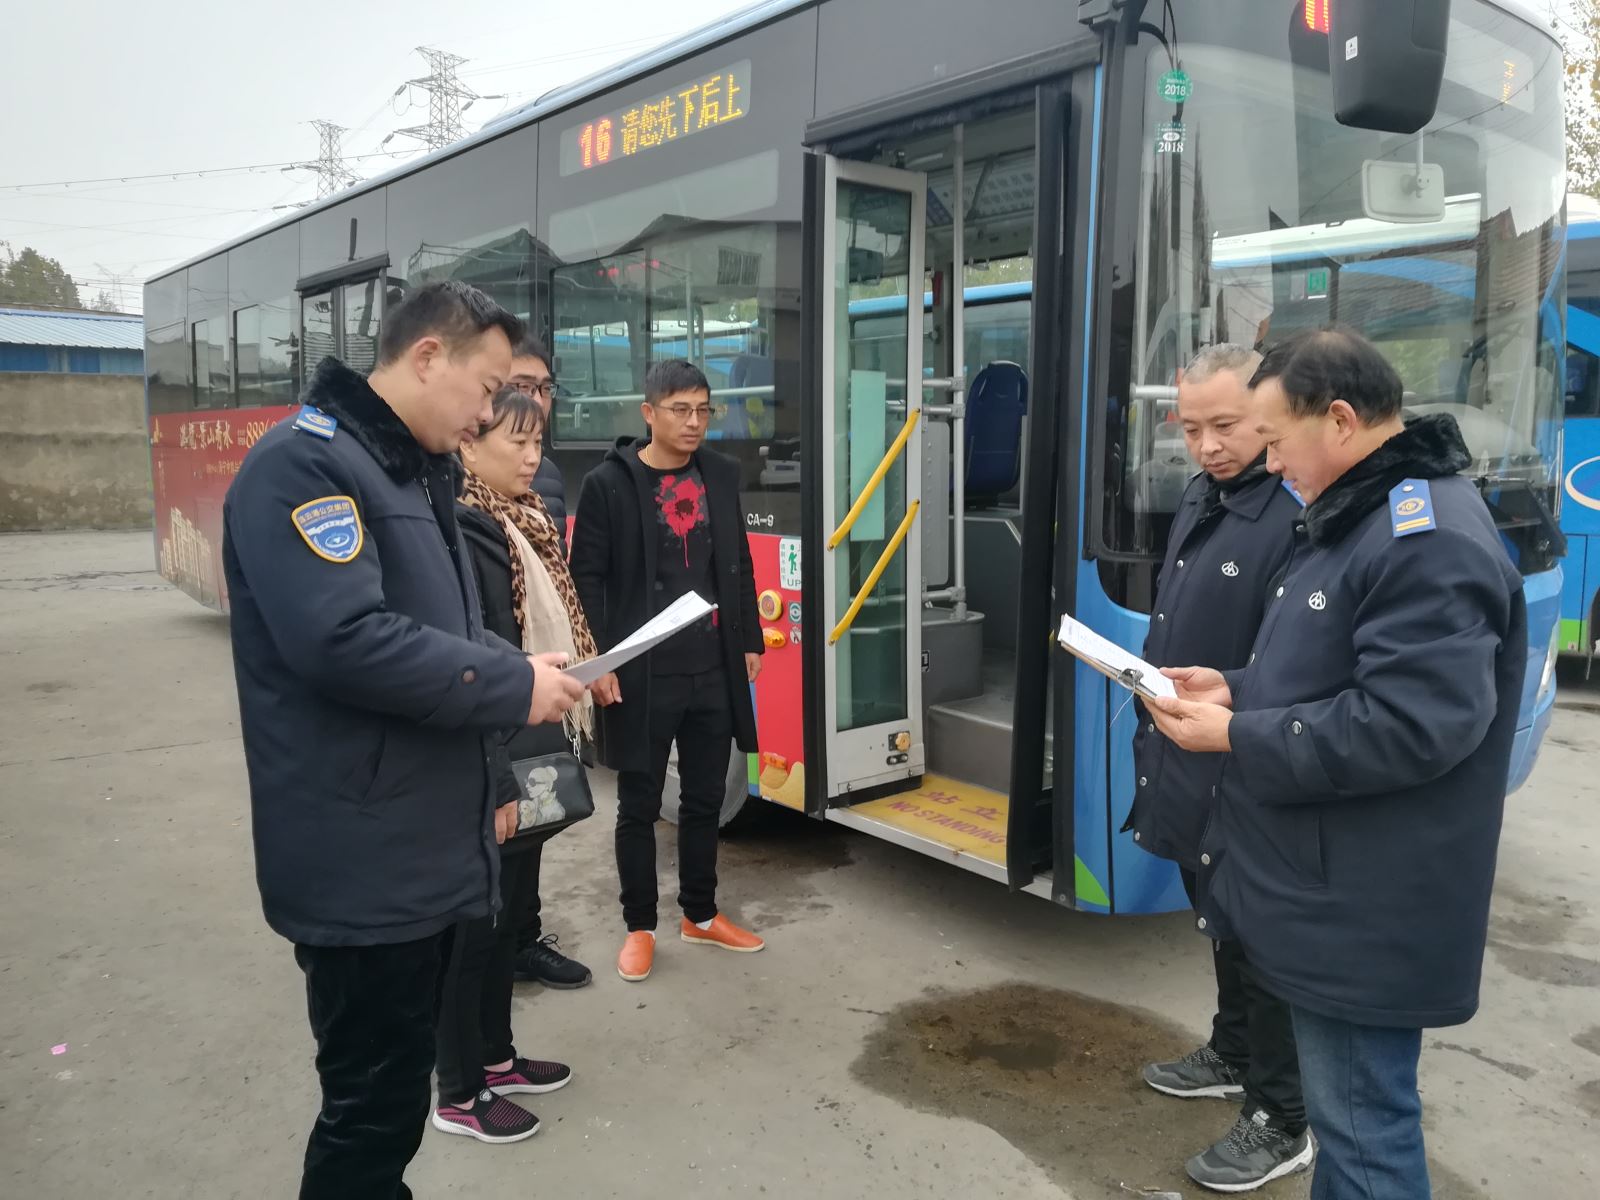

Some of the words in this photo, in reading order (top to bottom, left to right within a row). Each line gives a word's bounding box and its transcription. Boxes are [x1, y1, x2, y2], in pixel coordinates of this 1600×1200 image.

[1165, 84, 1186, 95] 2018
[580, 119, 611, 167] 16
[621, 74, 742, 155] 请您先下后上
[1158, 142, 1184, 153] 2018
[887, 801, 920, 814] NO
[914, 808, 1006, 844] STANDING
